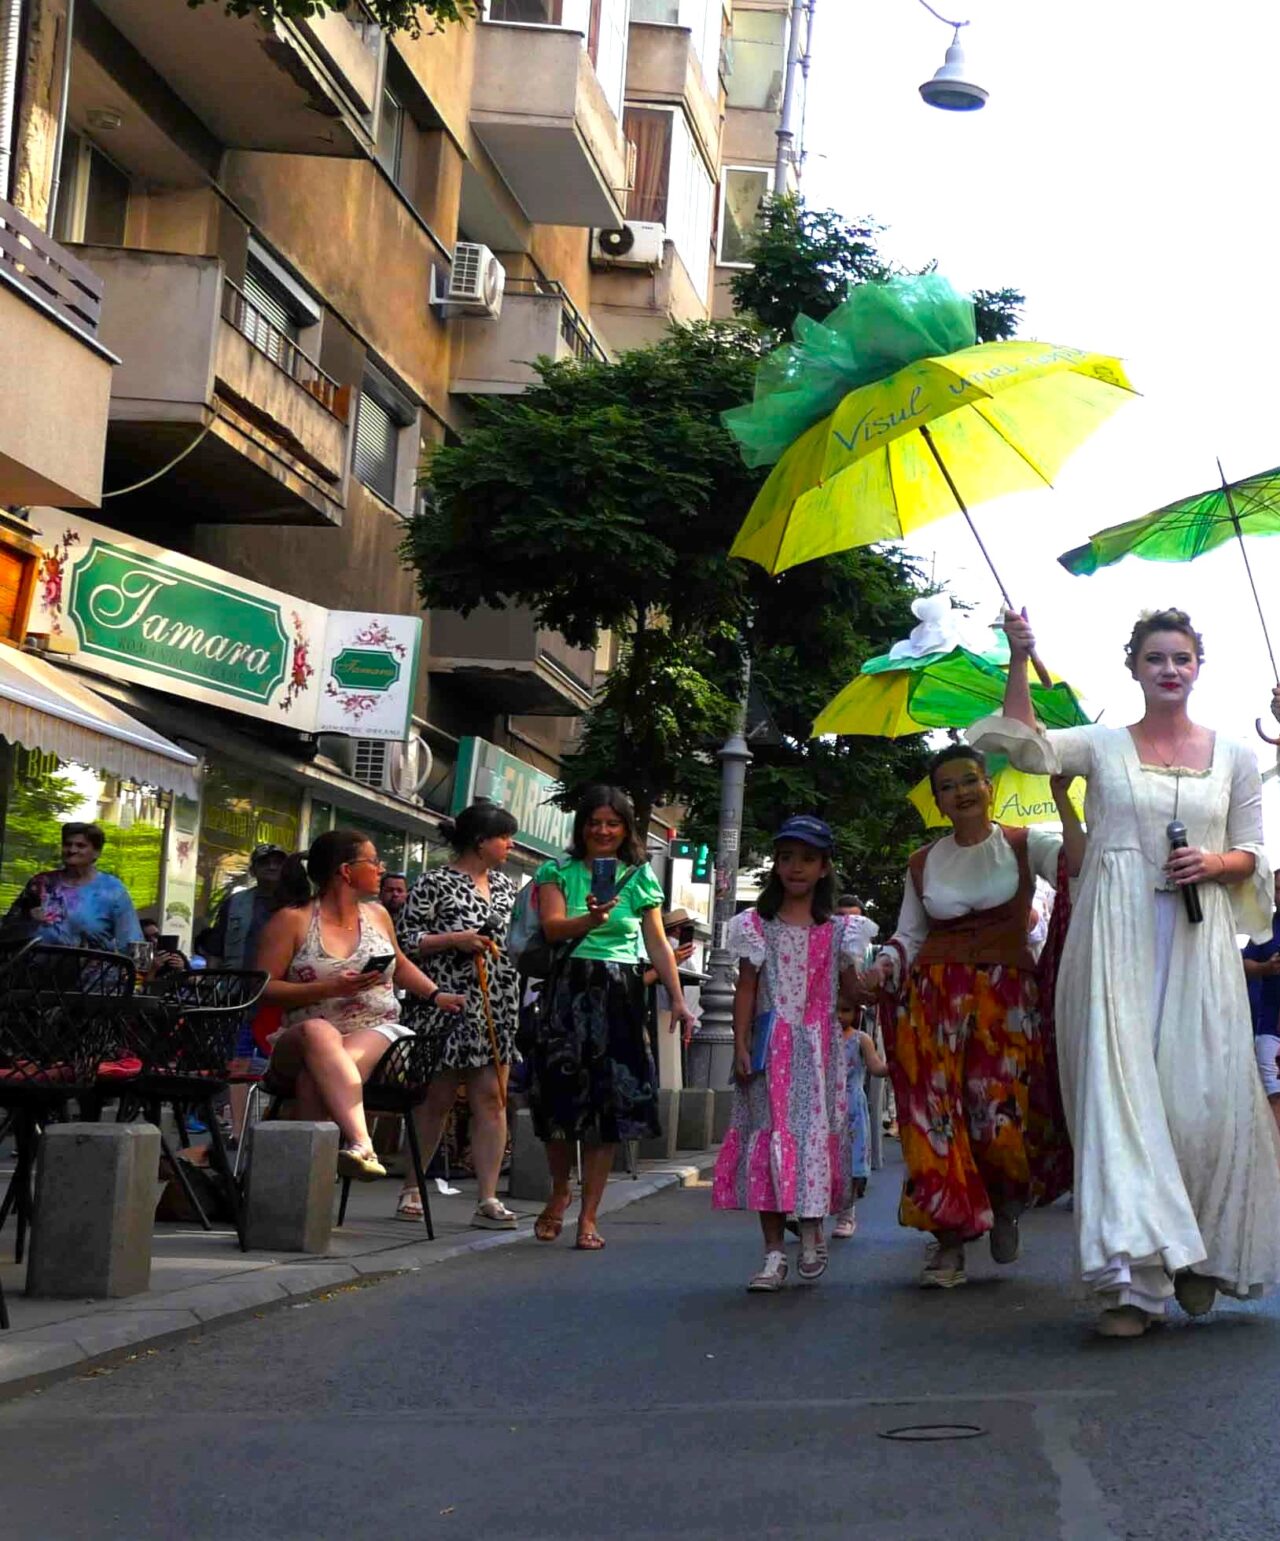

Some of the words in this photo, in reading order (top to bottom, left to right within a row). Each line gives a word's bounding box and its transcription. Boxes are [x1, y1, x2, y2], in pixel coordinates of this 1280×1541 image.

[831, 386, 932, 451] Visul
[89, 570, 271, 675] Tamara
[503, 766, 577, 850] FARMAC
[995, 793, 1058, 819] Aven
